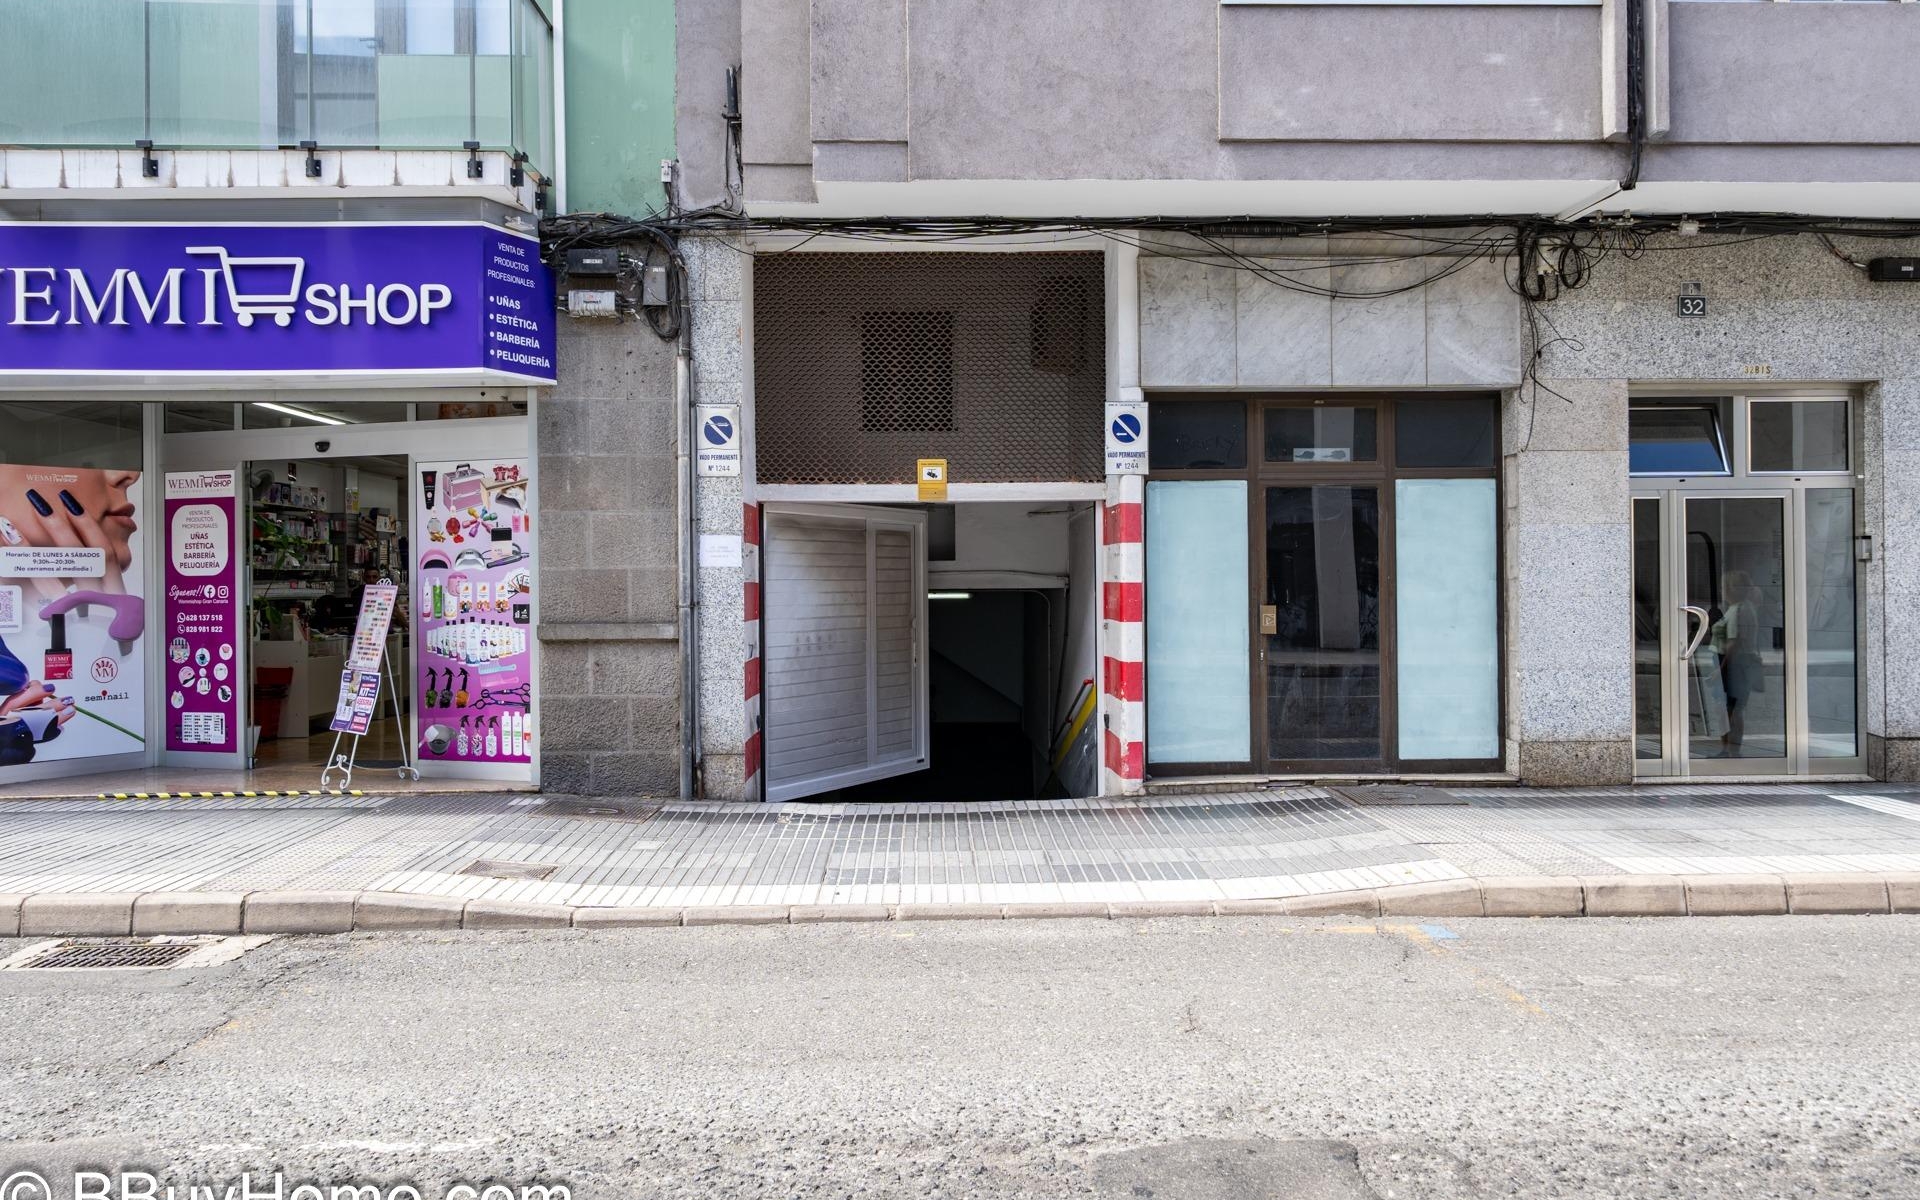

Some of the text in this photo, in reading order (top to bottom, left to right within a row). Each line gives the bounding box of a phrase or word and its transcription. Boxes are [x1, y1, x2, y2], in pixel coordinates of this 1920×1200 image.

[497, 242, 525, 257] VENTA DE
[493, 256, 530, 273] PRODUCTOS
[487, 269, 536, 289] PROFESIONALES:
[0, 266, 453, 327] EMMI SHOP
[496, 295, 521, 310] UÑAS
[1682, 299, 1704, 315] 32
[496, 314, 538, 332] ESTÉTICA
[496, 332, 540, 350] BARBERÍA
[496, 350, 551, 368] PELUQUERÍA
[1124, 462, 1139, 470] 1244
[168, 478, 232, 489] WEMMI SHOP
[190, 532, 209, 540] UÑAS
[184, 541, 215, 550] ESTÉTICA
[183, 551, 216, 560] BARBERÍA
[179, 560, 221, 569] PELUQUERÍA
[185, 614, 223, 622] 628 137 518
